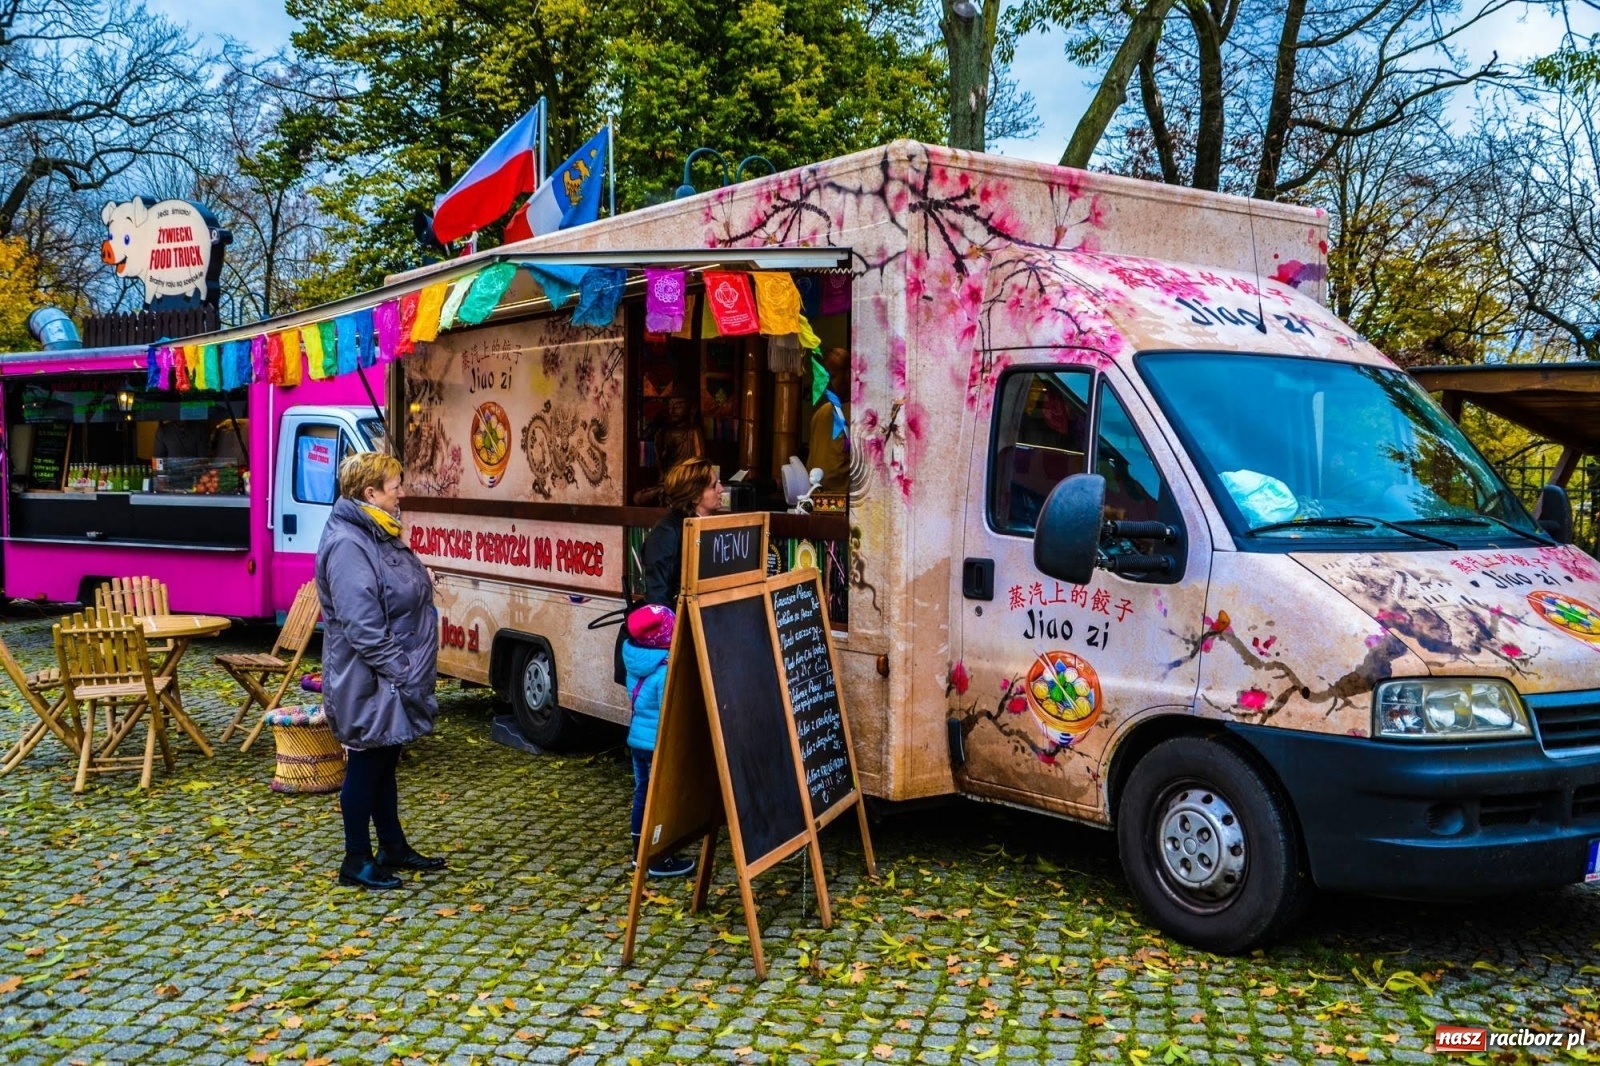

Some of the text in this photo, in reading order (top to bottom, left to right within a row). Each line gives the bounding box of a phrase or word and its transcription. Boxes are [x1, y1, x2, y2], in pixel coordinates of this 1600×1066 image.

[157, 226, 194, 244] ŻYWIECKI
[150, 246, 204, 270] FOOD TRUCK
[1175, 297, 1315, 337] Jiao zi
[470, 366, 512, 394] Jiao zi
[556, 539, 604, 577] PARZE
[712, 530, 750, 564] MENU
[1481, 570, 1562, 588] Jiao zi
[468, 624, 479, 652] zi
[1023, 608, 1110, 650] Jiao zi
